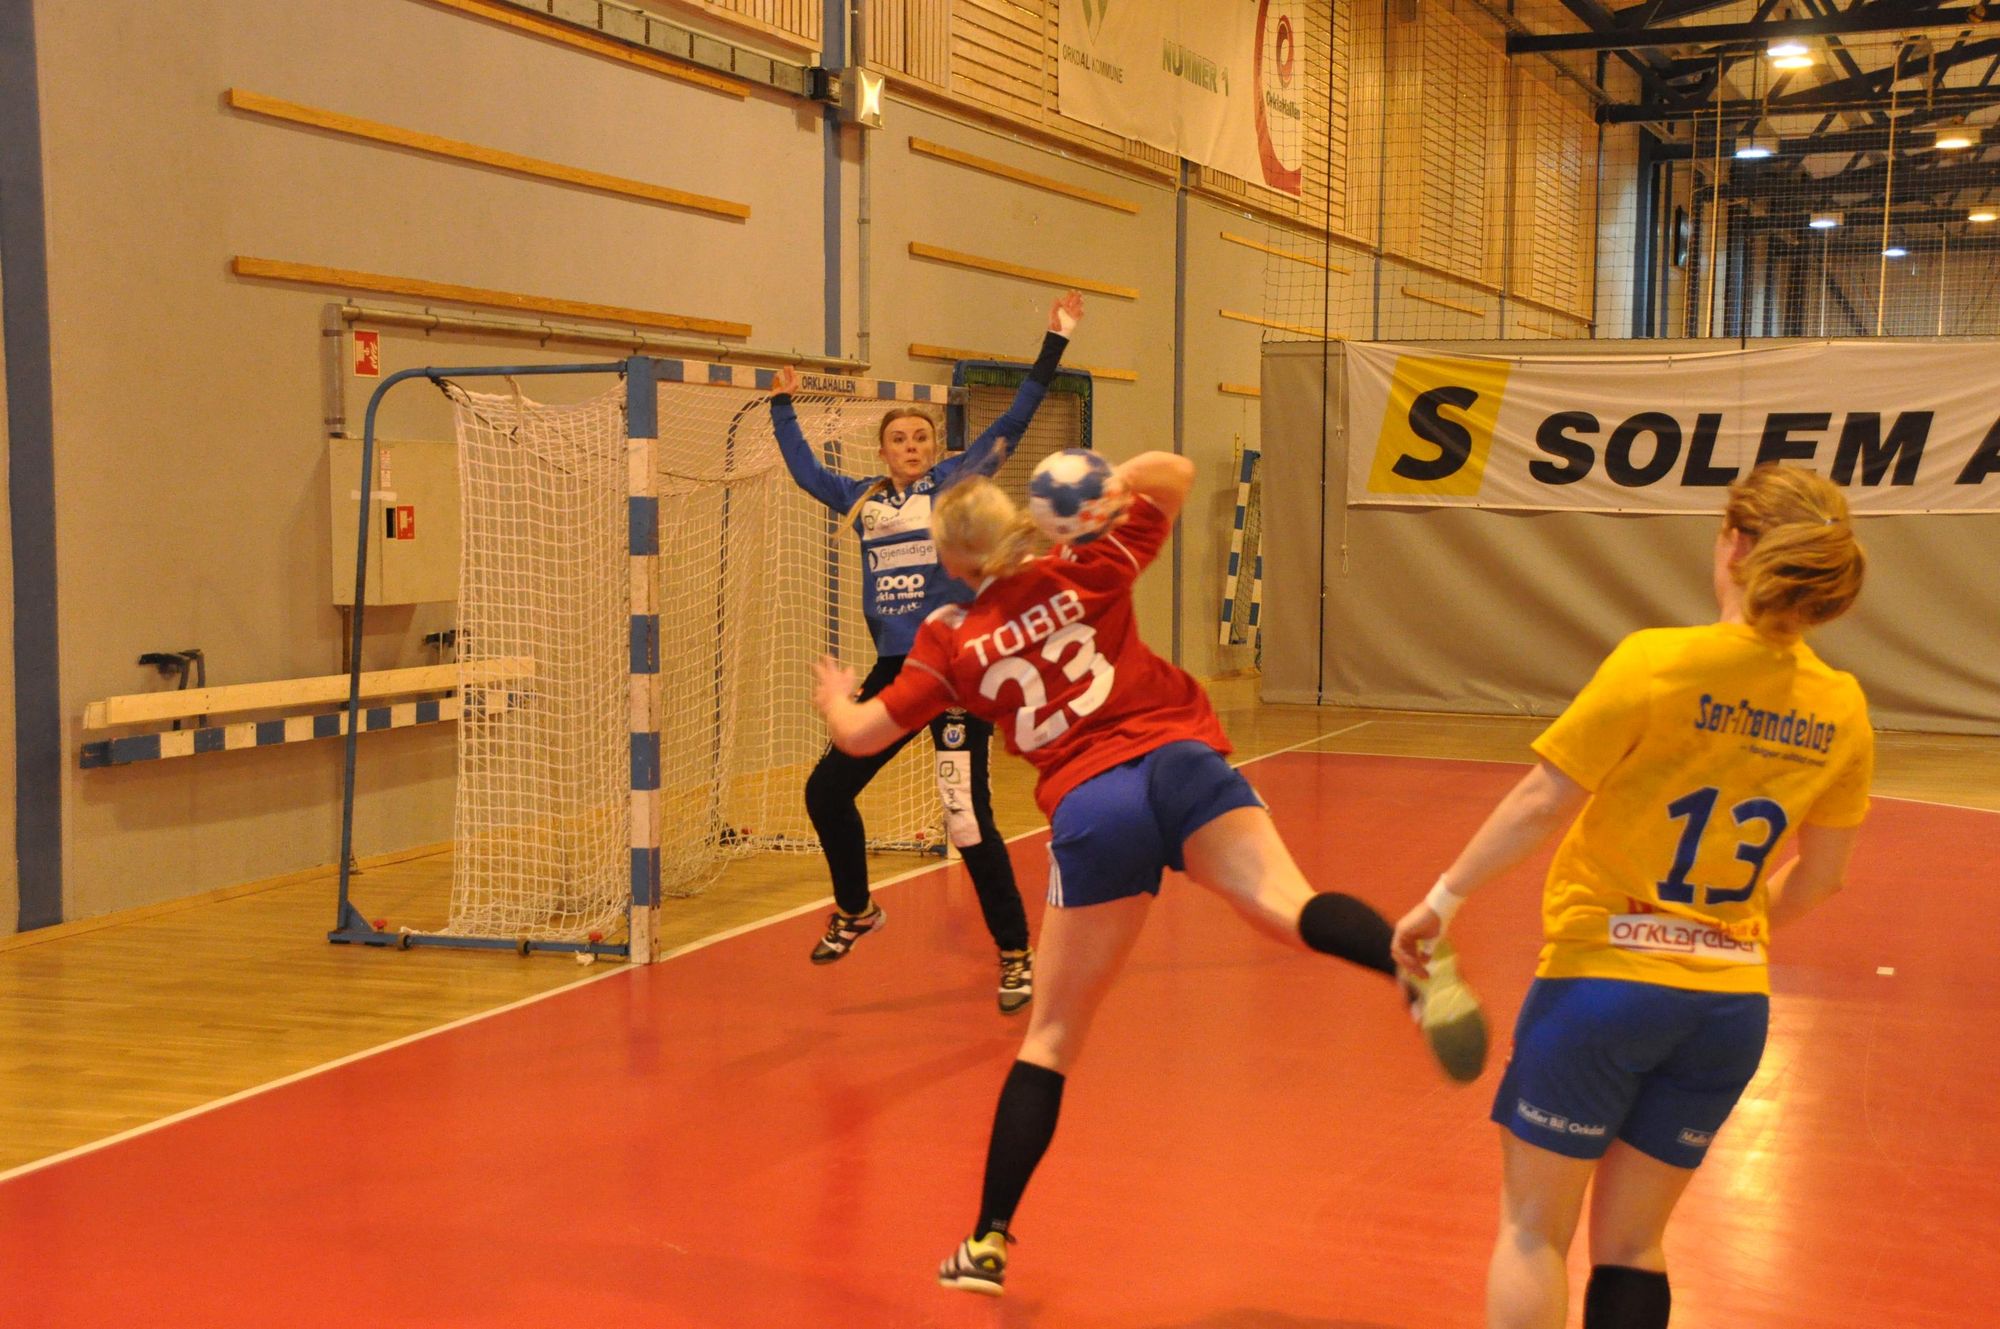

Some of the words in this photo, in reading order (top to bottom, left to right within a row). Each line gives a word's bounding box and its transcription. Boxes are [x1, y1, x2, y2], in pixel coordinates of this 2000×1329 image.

[1062, 43, 1090, 69] ORKDAL
[1091, 56, 1123, 84] KOMMUNE
[1162, 38, 1218, 94] NUMMER
[1221, 66, 1229, 97] 1
[801, 375, 856, 394] ORKLAHALLEN
[1391, 386, 1479, 481] S
[1528, 410, 1935, 487] SOLEM
[880, 543, 933, 560] Gjensidige
[963, 590, 1086, 668] TOBB
[979, 622, 1115, 753] 23
[1656, 786, 1788, 905] 13
